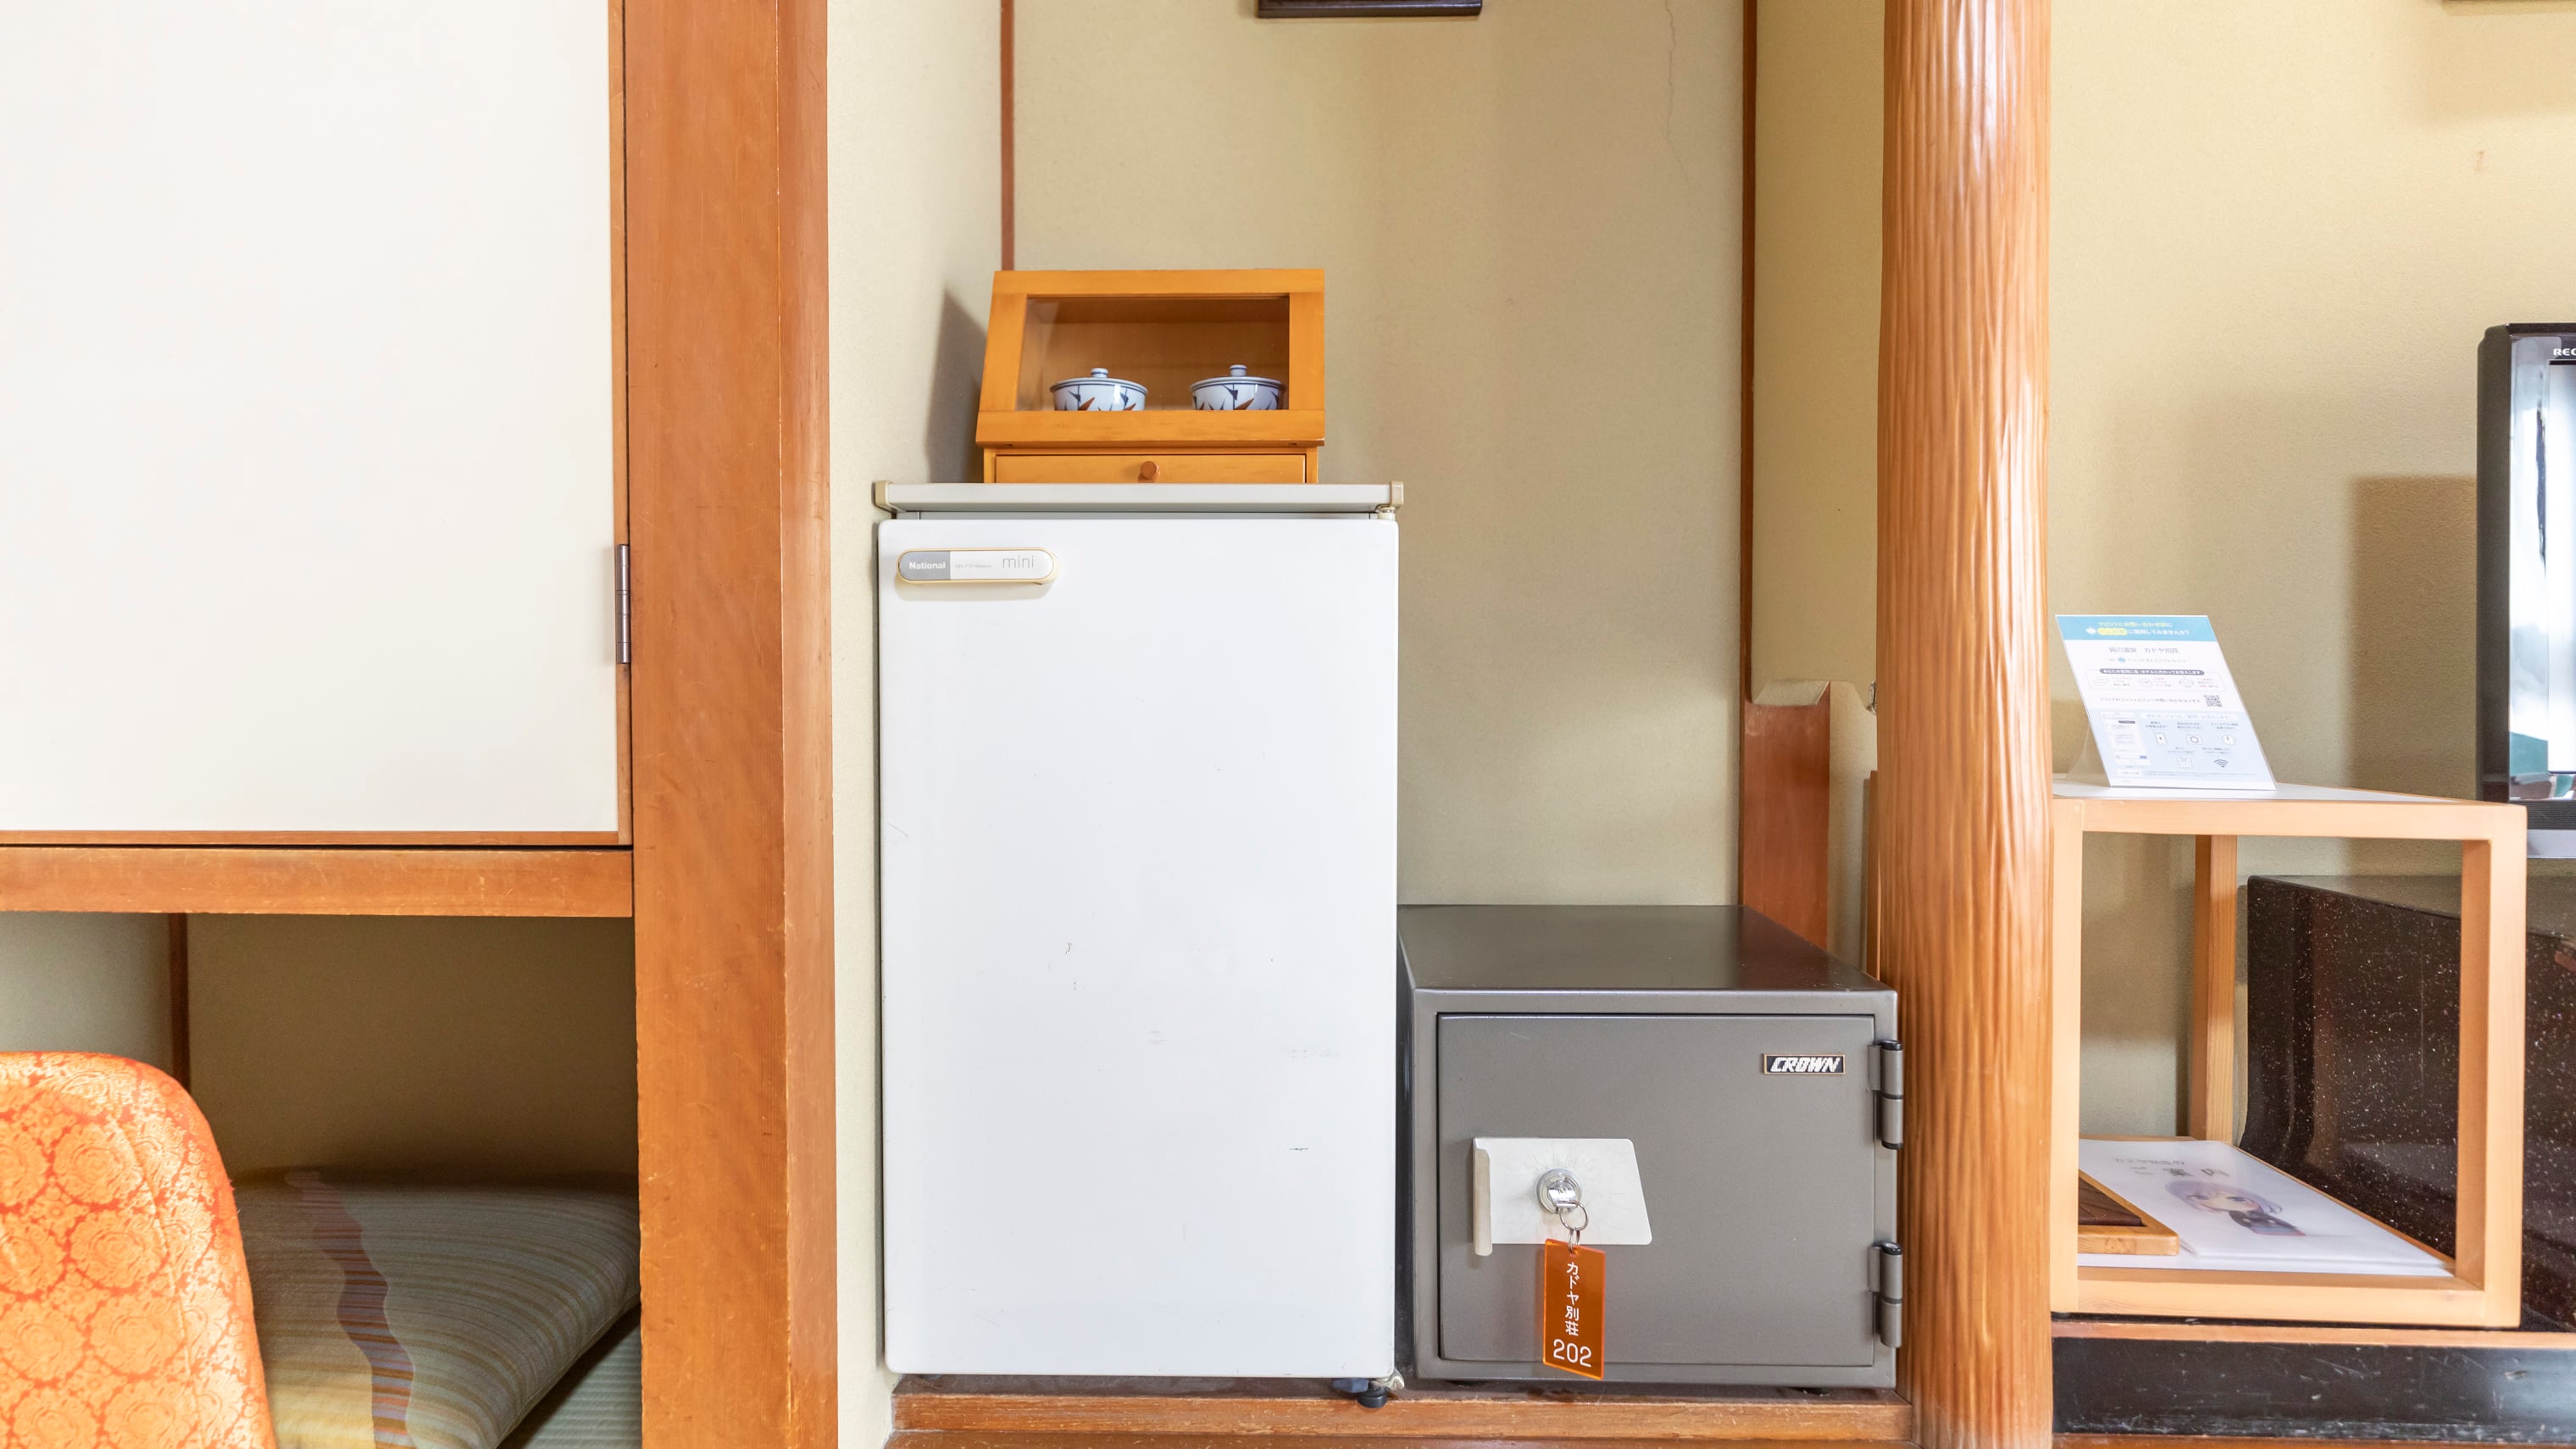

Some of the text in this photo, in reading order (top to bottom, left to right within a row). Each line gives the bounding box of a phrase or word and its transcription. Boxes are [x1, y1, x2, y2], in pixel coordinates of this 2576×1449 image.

[908, 561, 946, 570] National
[1002, 555, 1034, 569] mini
[1769, 1057, 1840, 1073] CROWN
[1565, 1261, 1580, 1336] カドヤ別荘
[1552, 1338, 1592, 1368] 202
